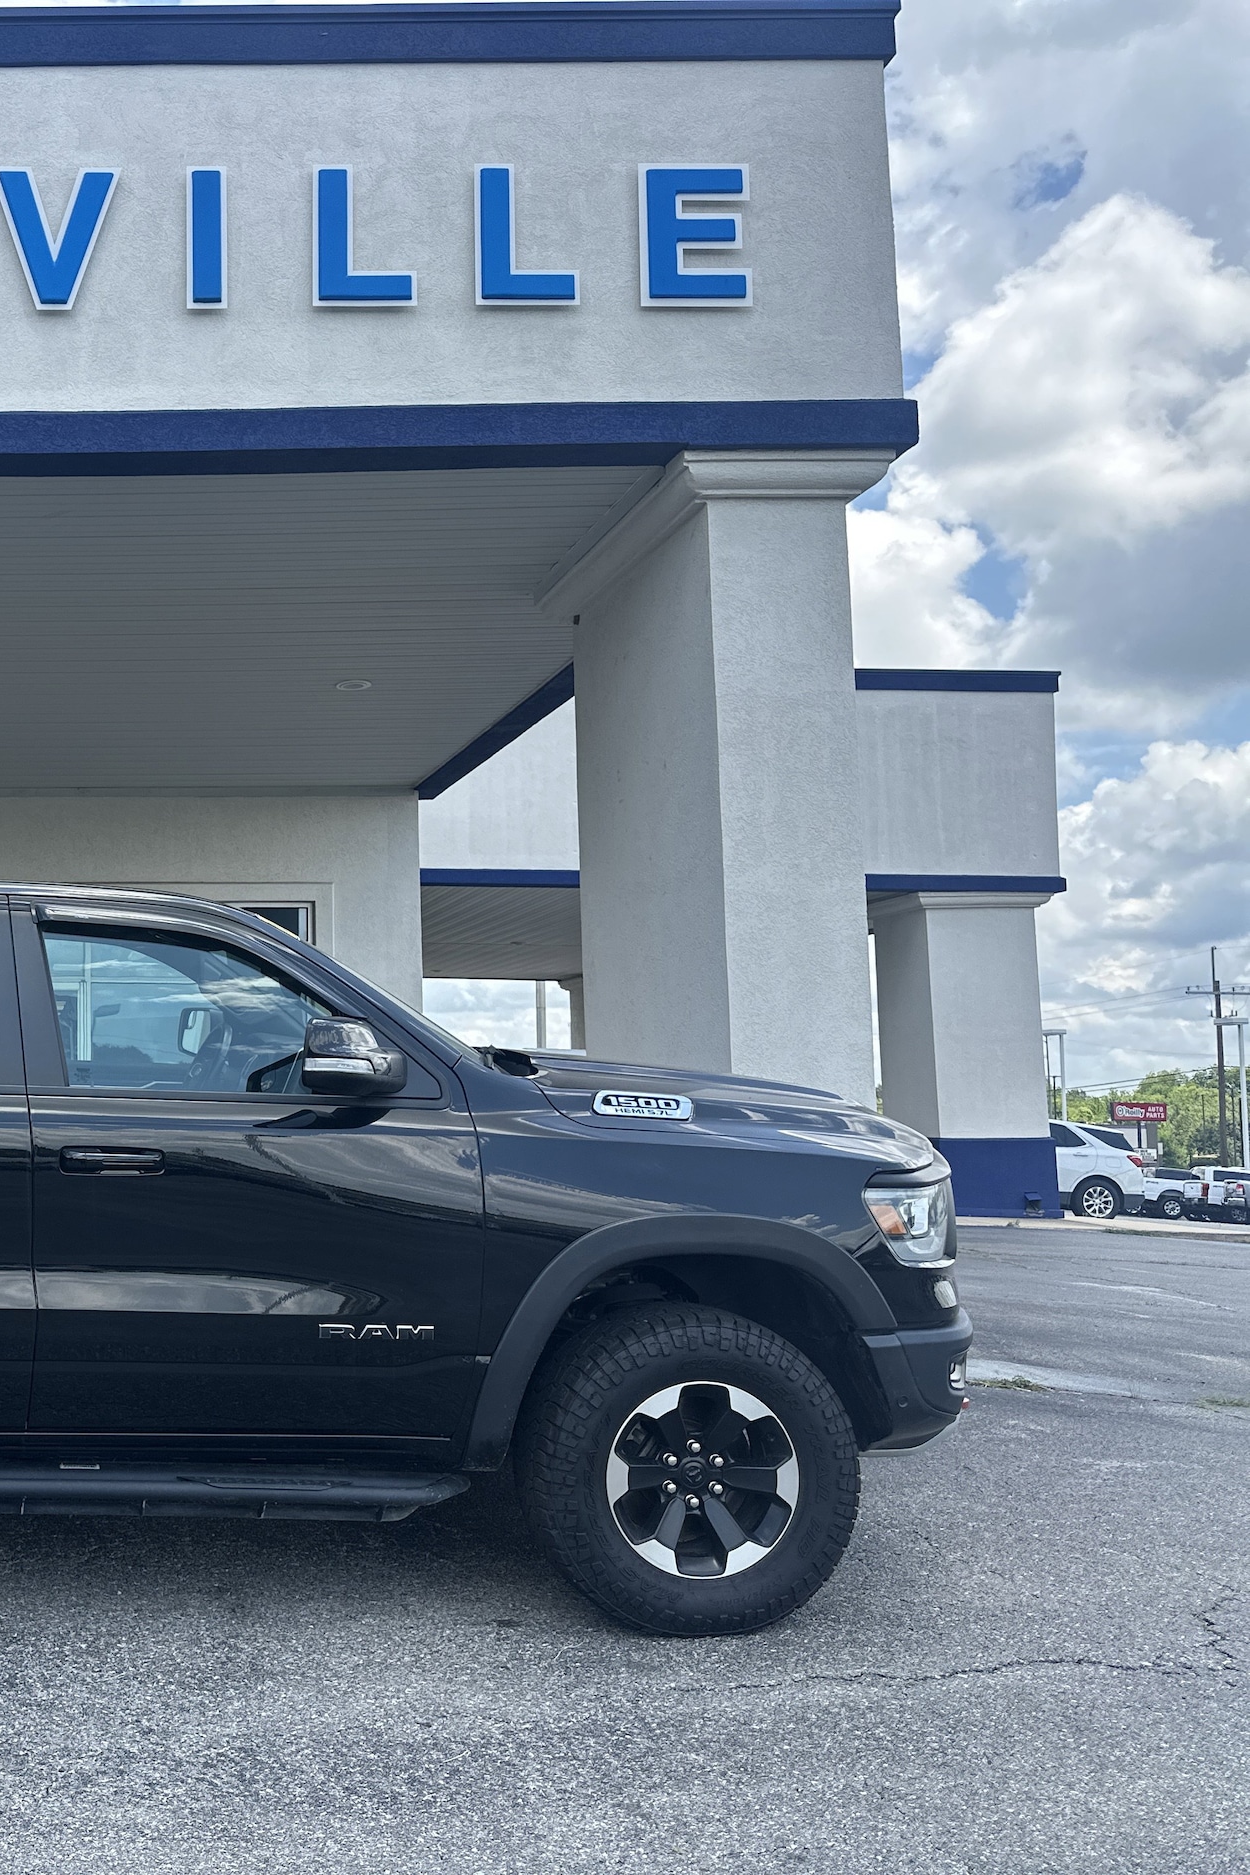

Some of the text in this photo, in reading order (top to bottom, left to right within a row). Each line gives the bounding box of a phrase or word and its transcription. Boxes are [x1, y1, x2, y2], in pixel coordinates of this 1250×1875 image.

[607, 1096, 677, 1110] 1500
[318, 1323, 435, 1340] RAM
[677, 1356, 806, 1412] COURSER
[805, 1425, 831, 1503] TRAIL
